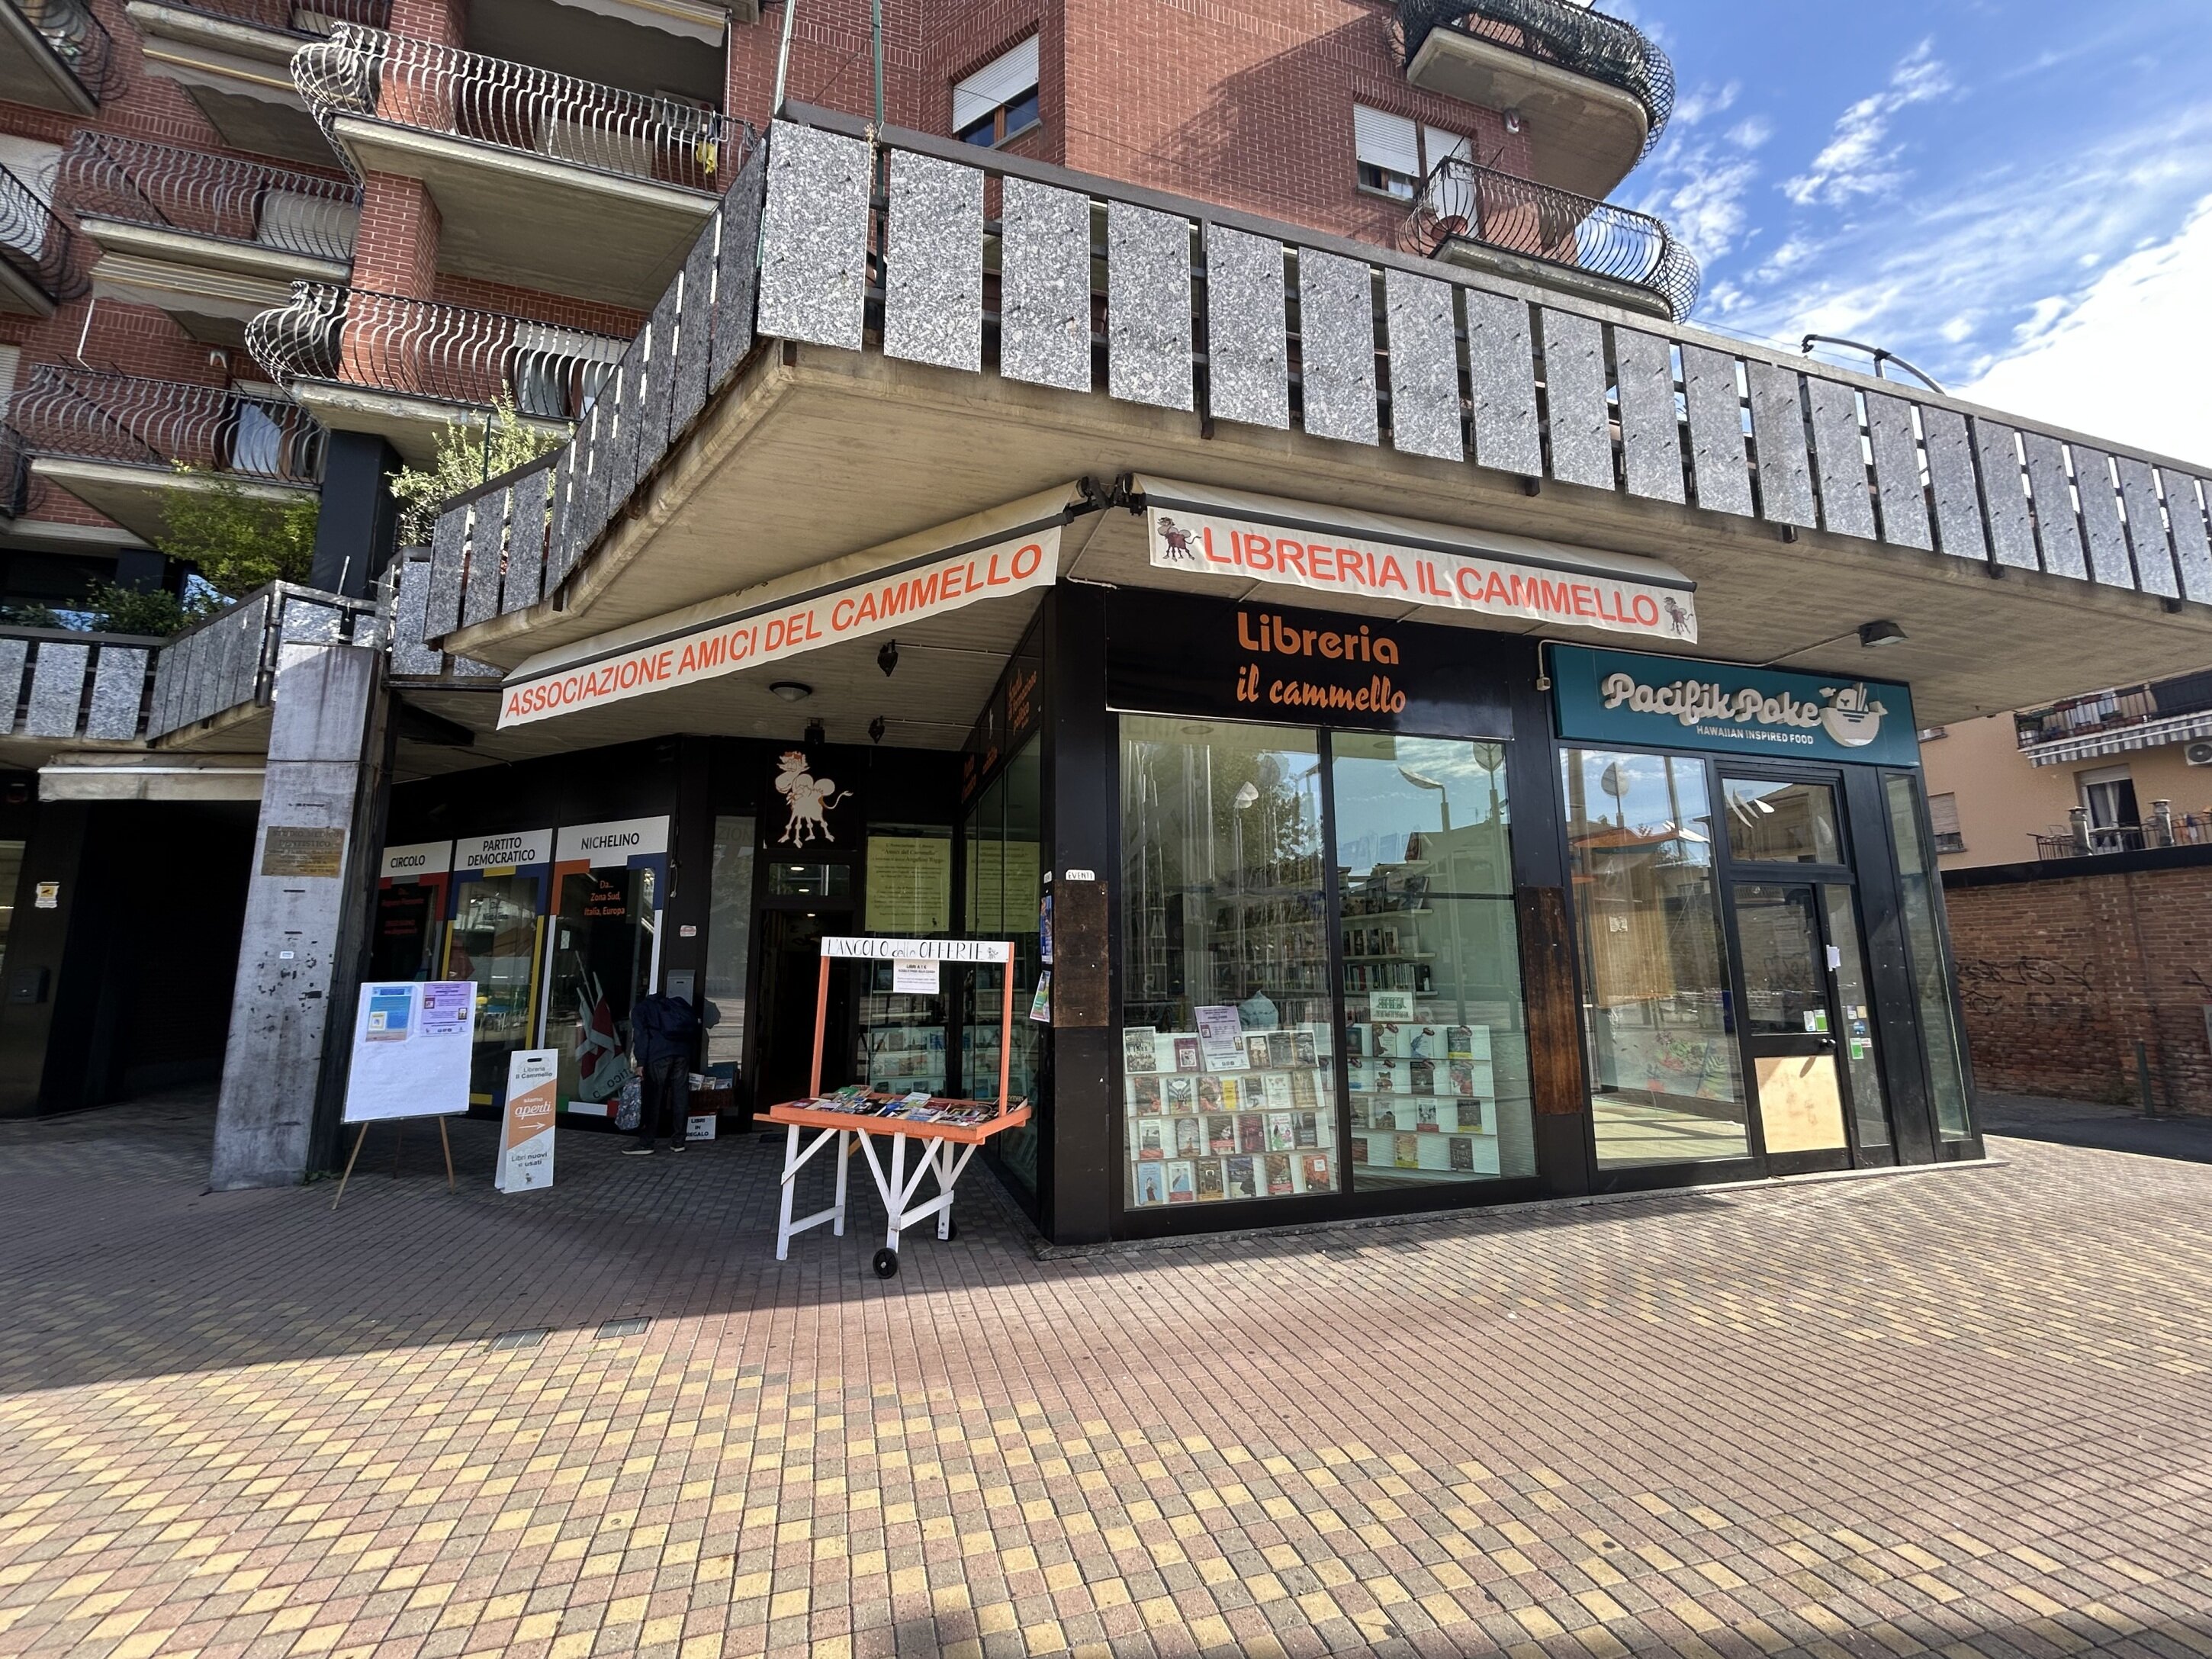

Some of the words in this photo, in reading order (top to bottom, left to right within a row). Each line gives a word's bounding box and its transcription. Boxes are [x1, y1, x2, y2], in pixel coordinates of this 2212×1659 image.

[1202, 526, 1409, 591] LIBRERIA
[1416, 561, 1452, 598] IL
[1456, 567, 1659, 627] CAMMELLO
[505, 650, 673, 719] ASSOCIAZIONE
[678, 626, 758, 675] AMICI
[764, 610, 823, 652] DEL
[832, 544, 1043, 632] CAMMELLO
[1237, 612, 1399, 665] Libreria
[1236, 664, 1259, 704] il
[1269, 676, 1406, 715] cammello
[1602, 672, 1735, 726] Pacifik
[1733, 686, 1822, 728] Poke
[1696, 725, 1744, 739] HAWAIIAN
[1746, 728, 1789, 744] INSPIRED
[1789, 733, 1815, 745] FOOD
[482, 837, 522, 852] PARTITO
[580, 832, 640, 850] NICHELINO
[390, 854, 426, 868] CIRCOLO
[467, 848, 535, 866] DEMOCRATICO
[1068, 870, 1093, 880] EVENTI
[590, 892, 606, 902] Zona
[602, 906, 625, 916] Europa
[827, 938, 889, 957] L'ANGOLO
[919, 940, 986, 960] OFFERTE
[514, 1101, 552, 1120] aperti
[511, 1154, 526, 1162] Libri
[524, 1159, 542, 1168] usati
